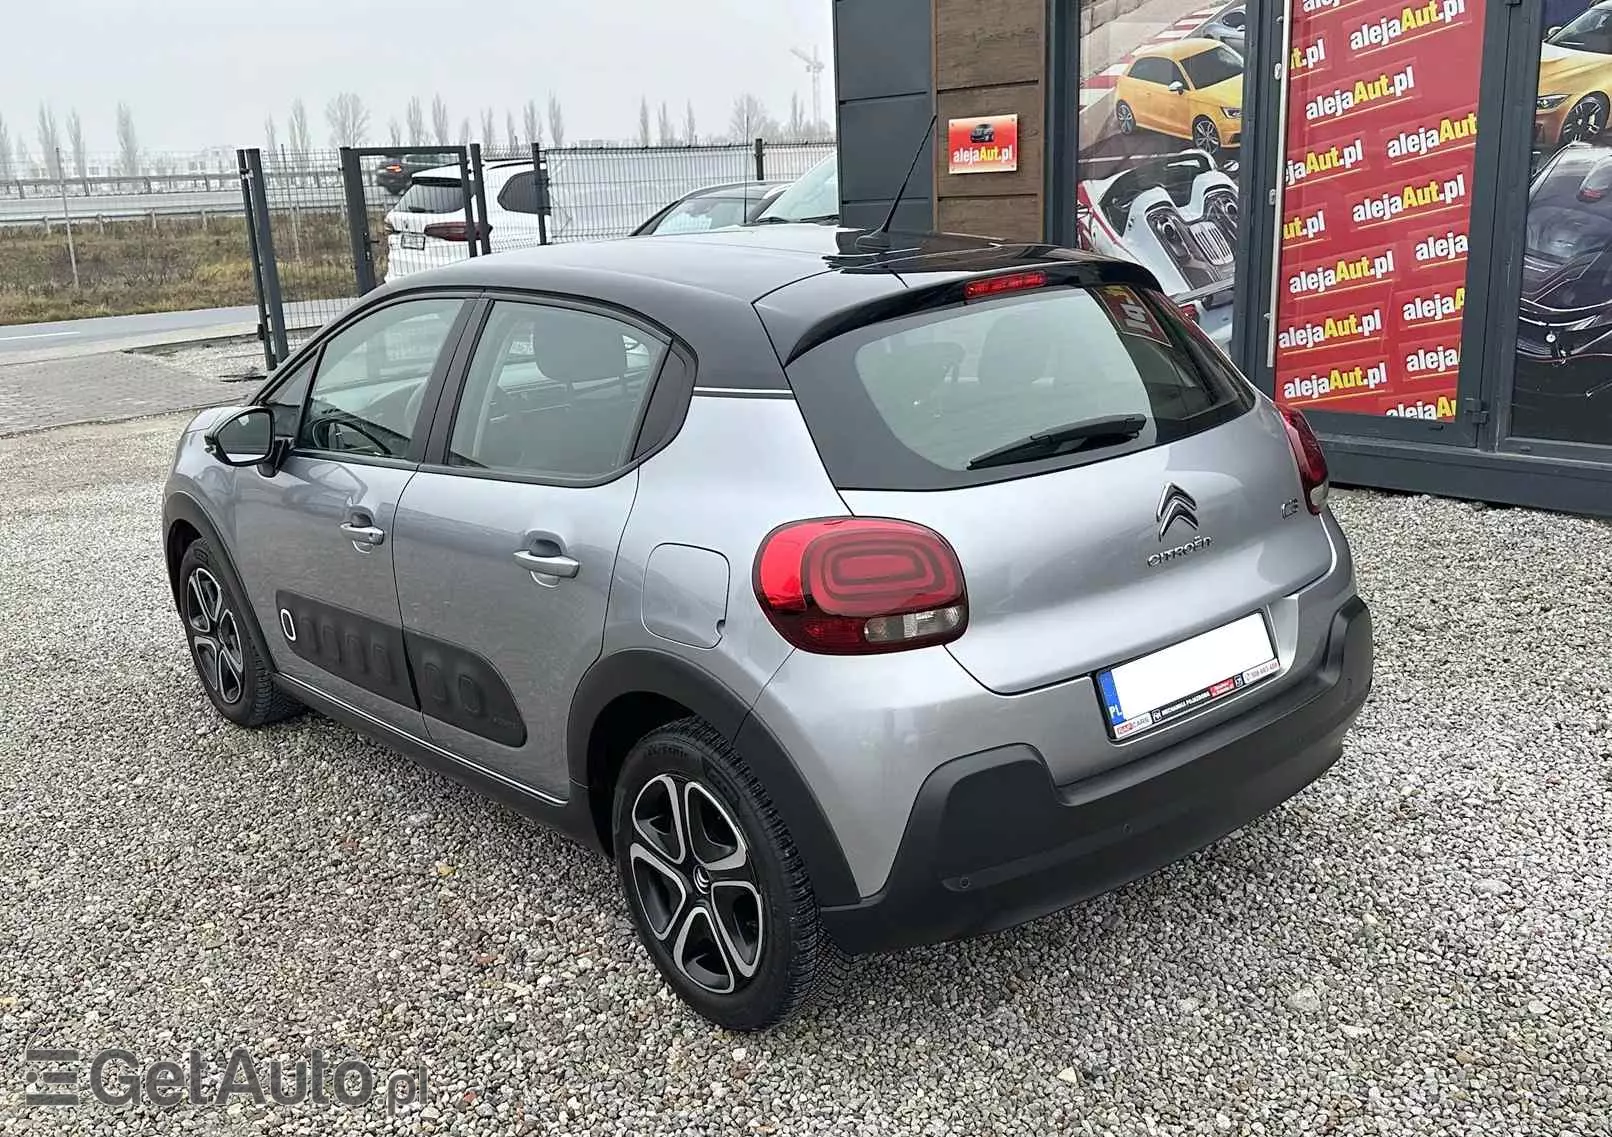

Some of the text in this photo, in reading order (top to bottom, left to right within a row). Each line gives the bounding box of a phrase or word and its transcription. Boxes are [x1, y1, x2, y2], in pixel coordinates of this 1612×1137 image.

[1350, 0, 1465, 50] alejaAut.pl
[1305, 65, 1415, 120] alejaAut.pl
[952, 145, 1013, 165] alejaAut.pl
[1387, 112, 1477, 158] alejaAut
[1352, 174, 1466, 222] alejaAut.pl
[1415, 232, 1468, 261] aleja
[1289, 250, 1395, 294] alejaAut.pl
[1278, 309, 1383, 349] alejaAut.pl
[1406, 341, 1461, 372] aleja
[1283, 362, 1388, 400] alejaAut.pl
[1109, 704, 1123, 719] PL
